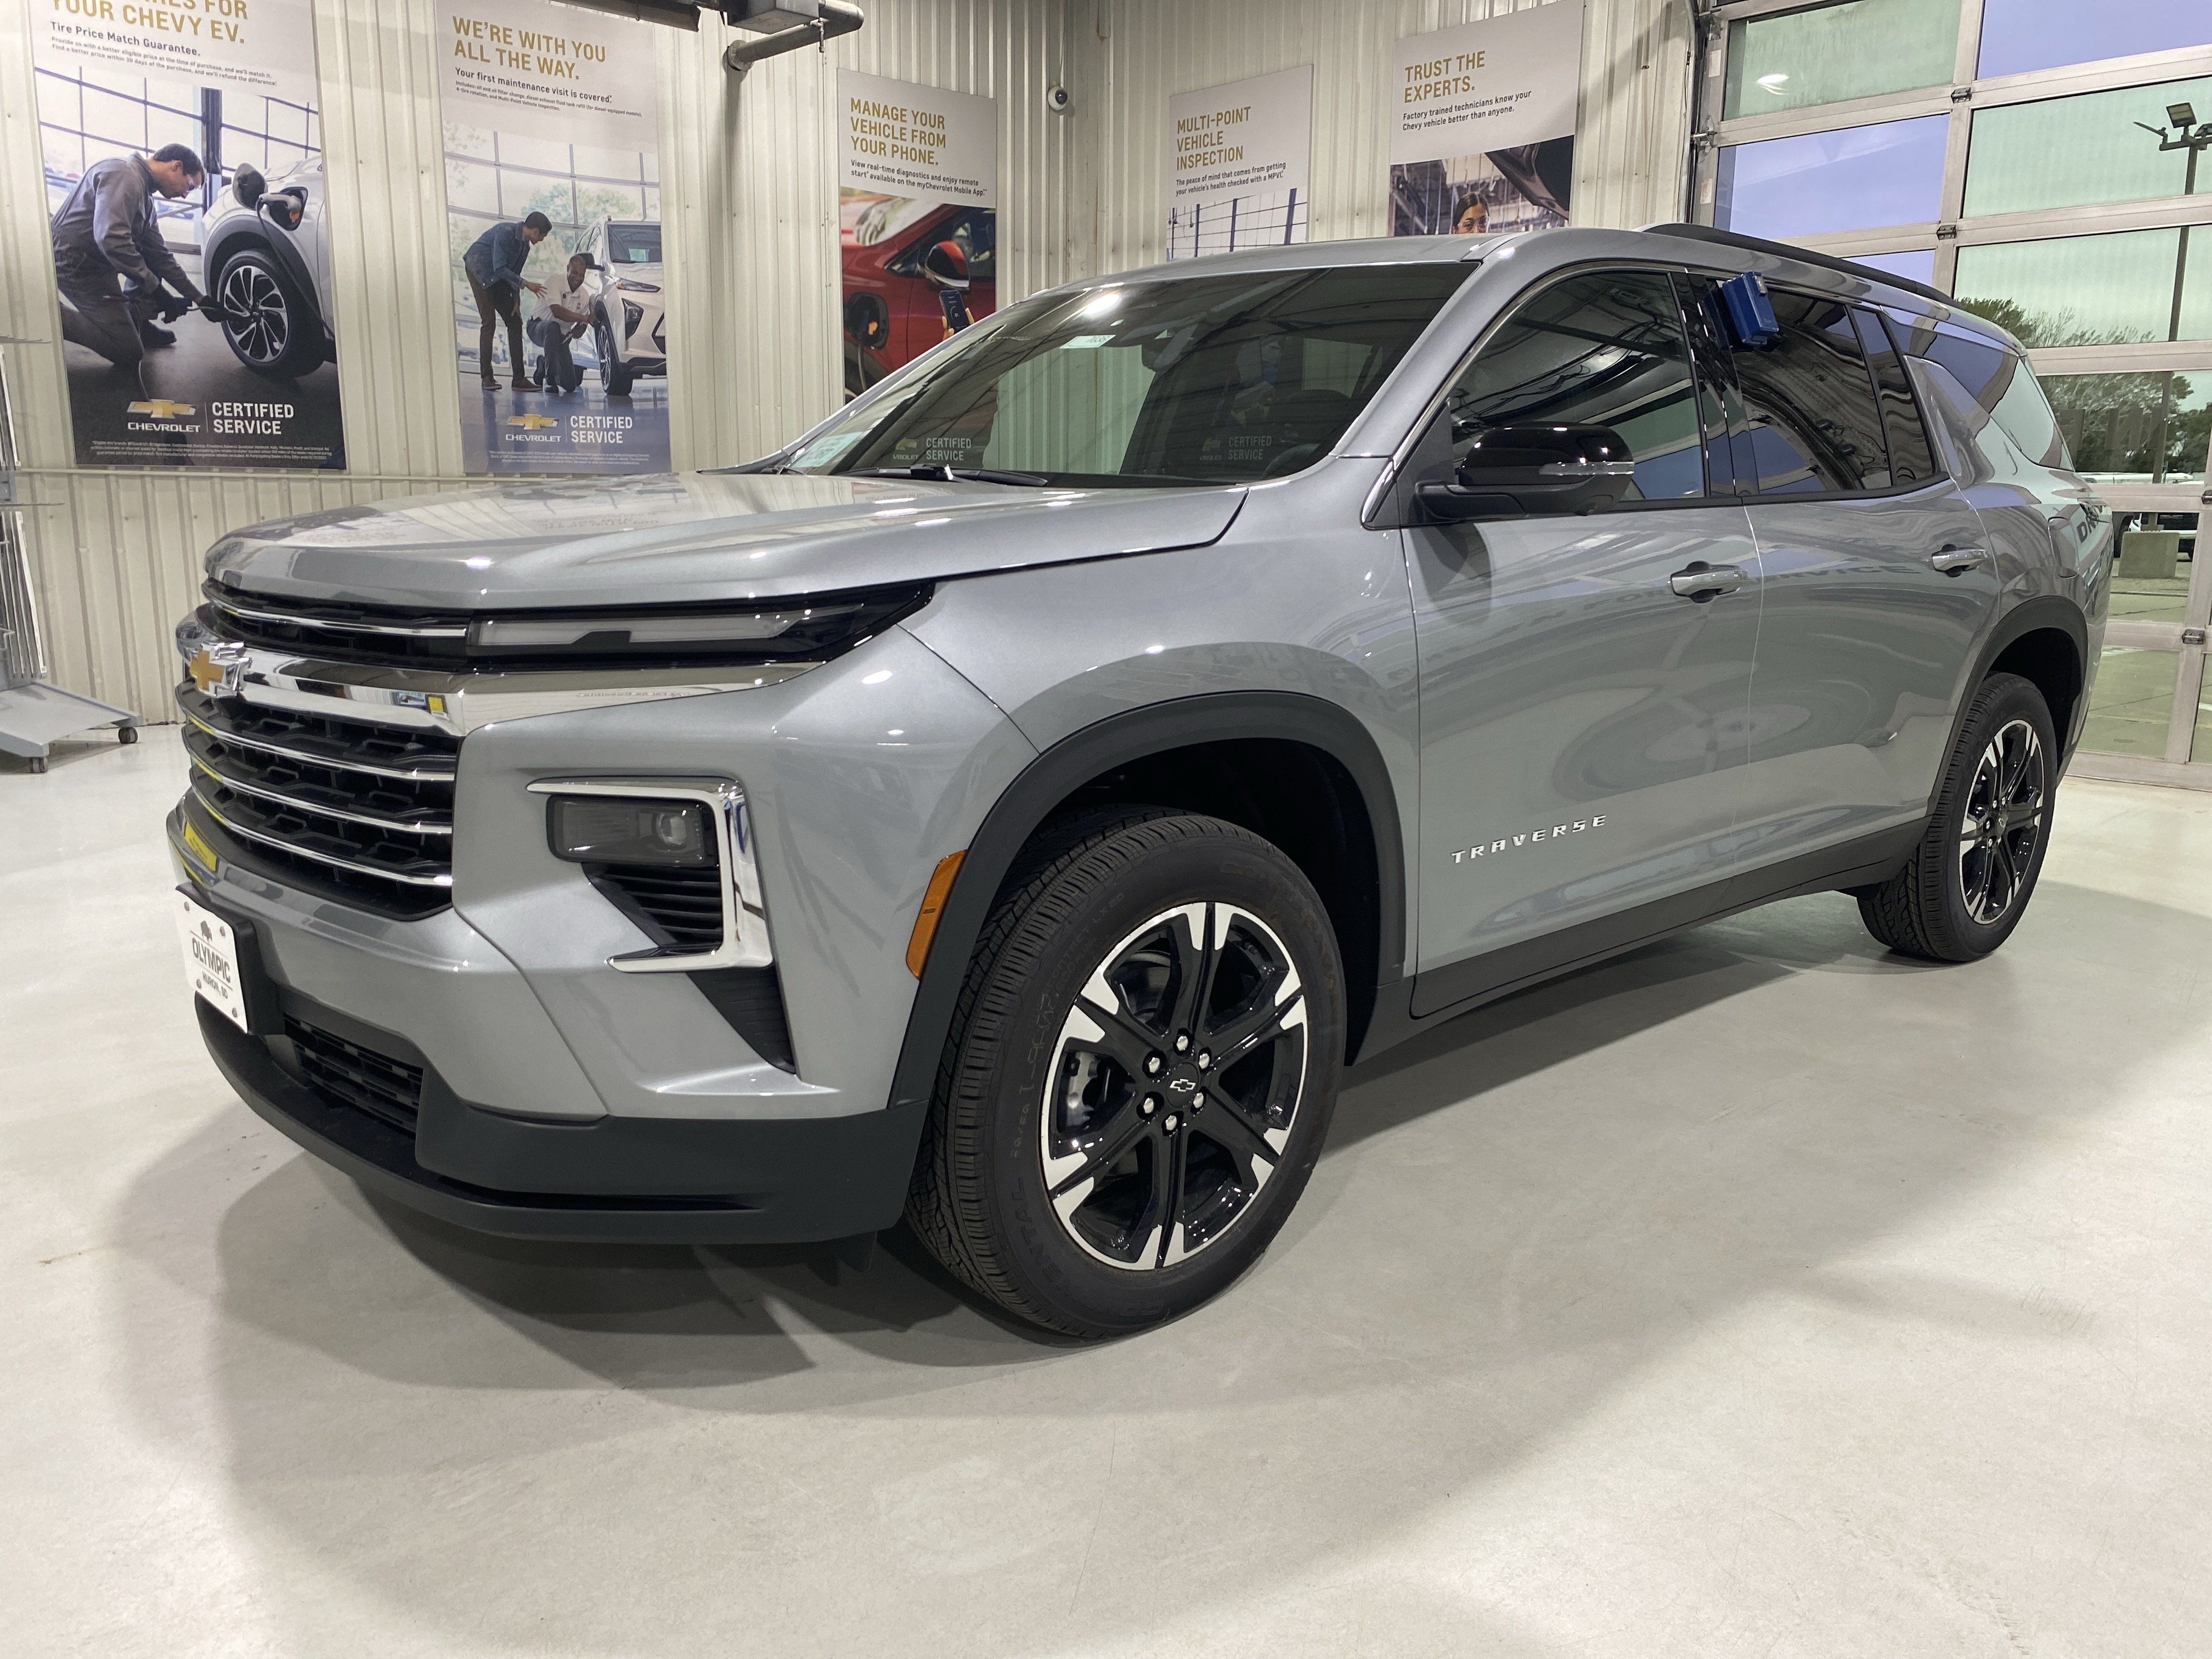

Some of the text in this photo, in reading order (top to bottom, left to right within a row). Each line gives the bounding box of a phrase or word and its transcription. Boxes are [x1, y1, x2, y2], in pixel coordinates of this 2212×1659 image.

[205, 0, 247, 19] FOR
[122, 4, 202, 36] CHEVY
[211, 19, 245, 43] EV.
[50, 21, 200, 56] Tire Price Match Guarantee.
[518, 30, 565, 55] WITH
[571, 40, 605, 62] YOU
[454, 40, 579, 80] ALL THE WAY.
[1404, 50, 1485, 82] TRUST THE
[454, 66, 475, 78] Your
[476, 71, 495, 83] first
[497, 77, 550, 93] maintenance
[551, 86, 568, 97] visit
[570, 88, 577, 98] is
[1404, 75, 1474, 103] EXPERTS.
[850, 97, 945, 129] MANAGE YOUR
[1402, 105, 1514, 131] Chevy vehicle better than anyone.
[1403, 91, 1532, 120] Factory trained technicians know your
[1177, 106, 1250, 133] MULTI-POINT
[850, 117, 946, 148] VEHICLE FROM
[1176, 130, 1223, 152] VEHICLE
[850, 136, 938, 165] YOUR PHONE.
[1176, 145, 1243, 170] INSPECTION
[850, 159, 866, 169] View
[866, 163, 895, 173] real-time
[896, 167, 929, 179] diagnostics
[942, 176, 958, 185] enjoy
[870, 173, 895, 183] available
[905, 178, 915, 187] the
[916, 182, 952, 192] myChevrolet
[953, 185, 972, 194] Mobile
[1186, 177, 1200, 186] peace
[1201, 173, 1207, 182] of
[1207, 172, 1221, 180] mind
[1221, 171, 1233, 179] that
[1233, 168, 1251, 177] comes
[1266, 162, 1286, 173] getting
[1175, 188, 1187, 197] your
[1188, 183, 1209, 193] vehicle's
[1210, 180, 1226, 190] health
[1227, 177, 1249, 187] checked
[1250, 174, 1262, 183] with
[212, 402, 294, 419] CERTIFIED
[570, 415, 633, 429] CERTIFIED
[127, 422, 201, 433] CHEVROLET
[213, 419, 282, 435] SERVICE
[505, 434, 561, 442] CHEVROLET
[571, 431, 623, 444] SERVICE
[926, 438, 972, 449] CERTIFIED
[1228, 436, 1272, 447] CERTIFIED
[926, 450, 964, 461] SERVICE
[1228, 449, 1264, 460] SERVICE
[1451, 815, 1606, 864] TRAVERSE
[192, 937, 231, 983] OLYMPIC
